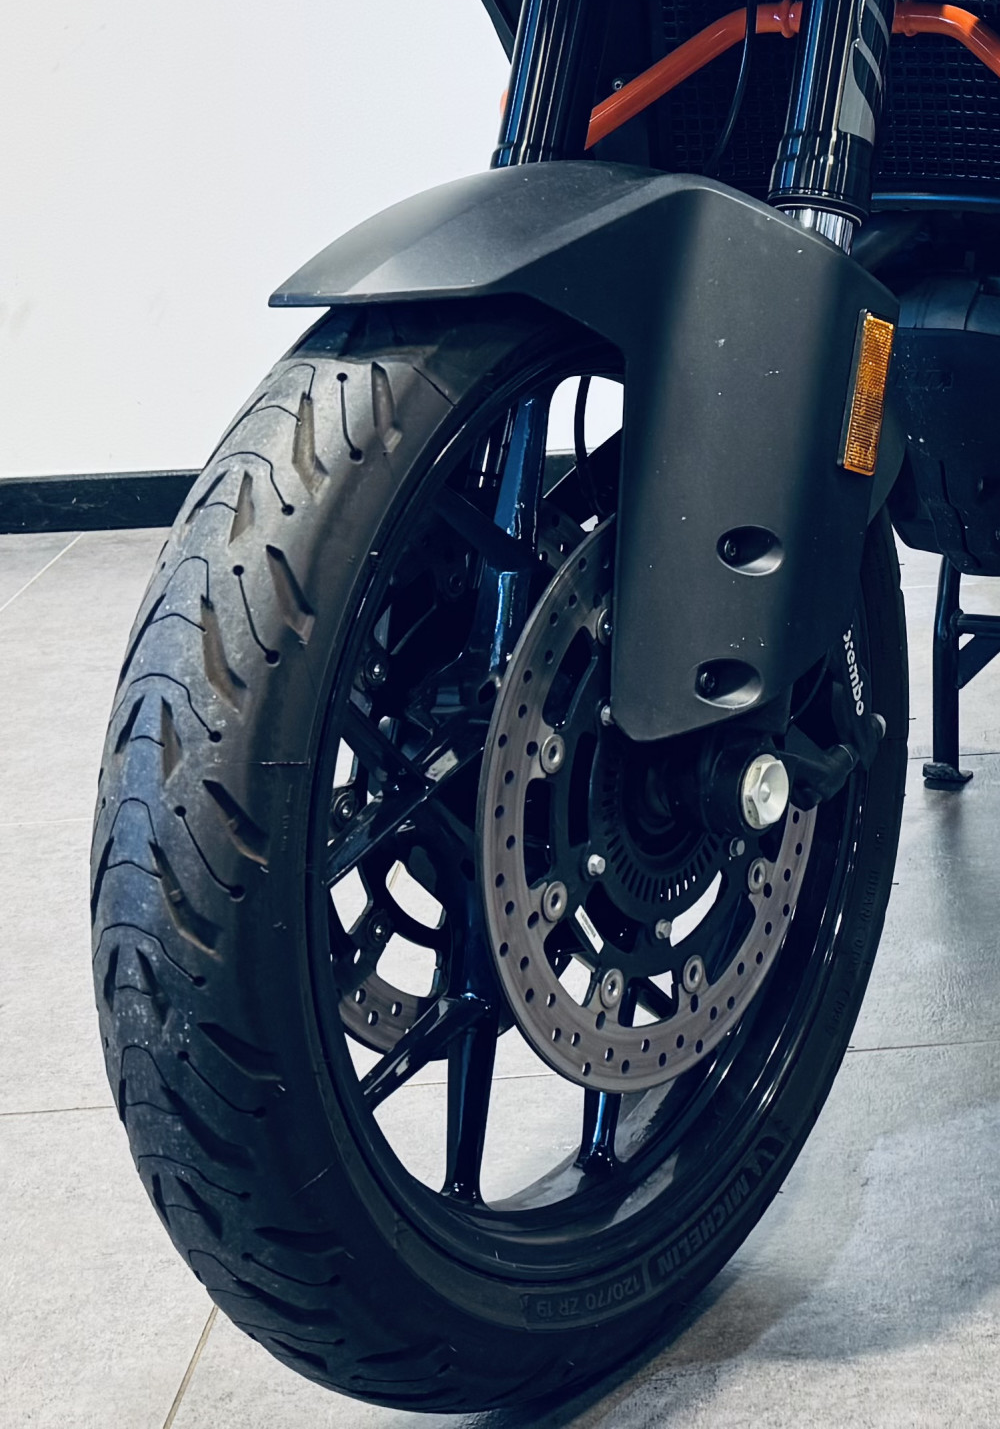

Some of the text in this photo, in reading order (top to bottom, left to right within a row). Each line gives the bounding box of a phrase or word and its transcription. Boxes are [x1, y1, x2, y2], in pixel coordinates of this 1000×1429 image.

[657, 1173, 751, 1276] MICHELIN
[559, 1298, 580, 1317] ZR
[586, 1275, 645, 1311] 120/70
